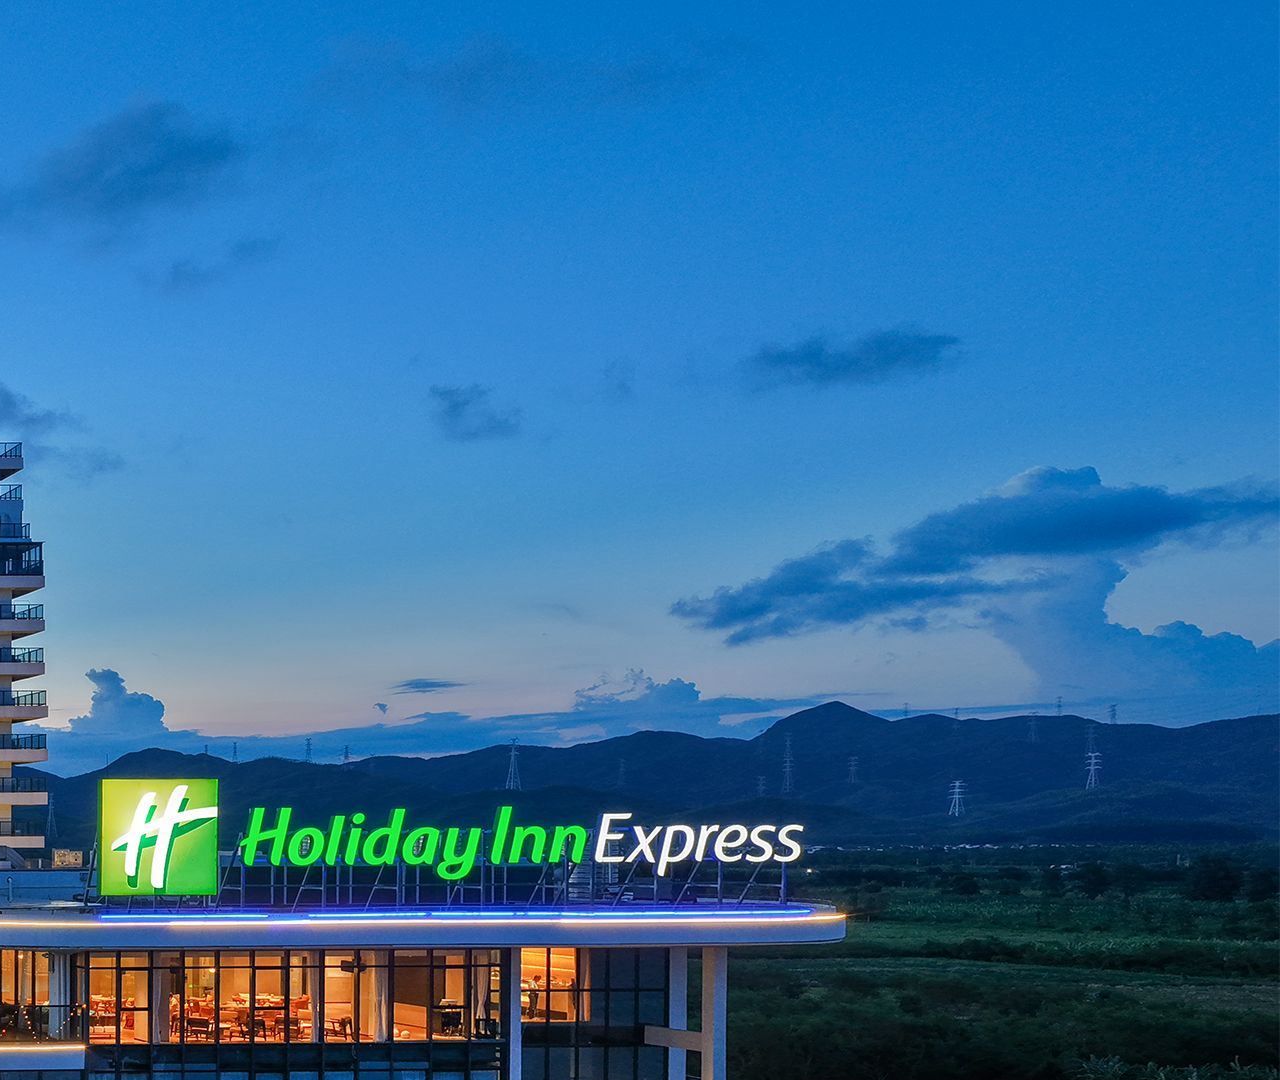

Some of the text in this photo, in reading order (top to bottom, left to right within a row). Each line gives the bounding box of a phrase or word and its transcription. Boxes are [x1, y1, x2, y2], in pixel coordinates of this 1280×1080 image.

[240, 805, 804, 880] Holiday Inn Express
